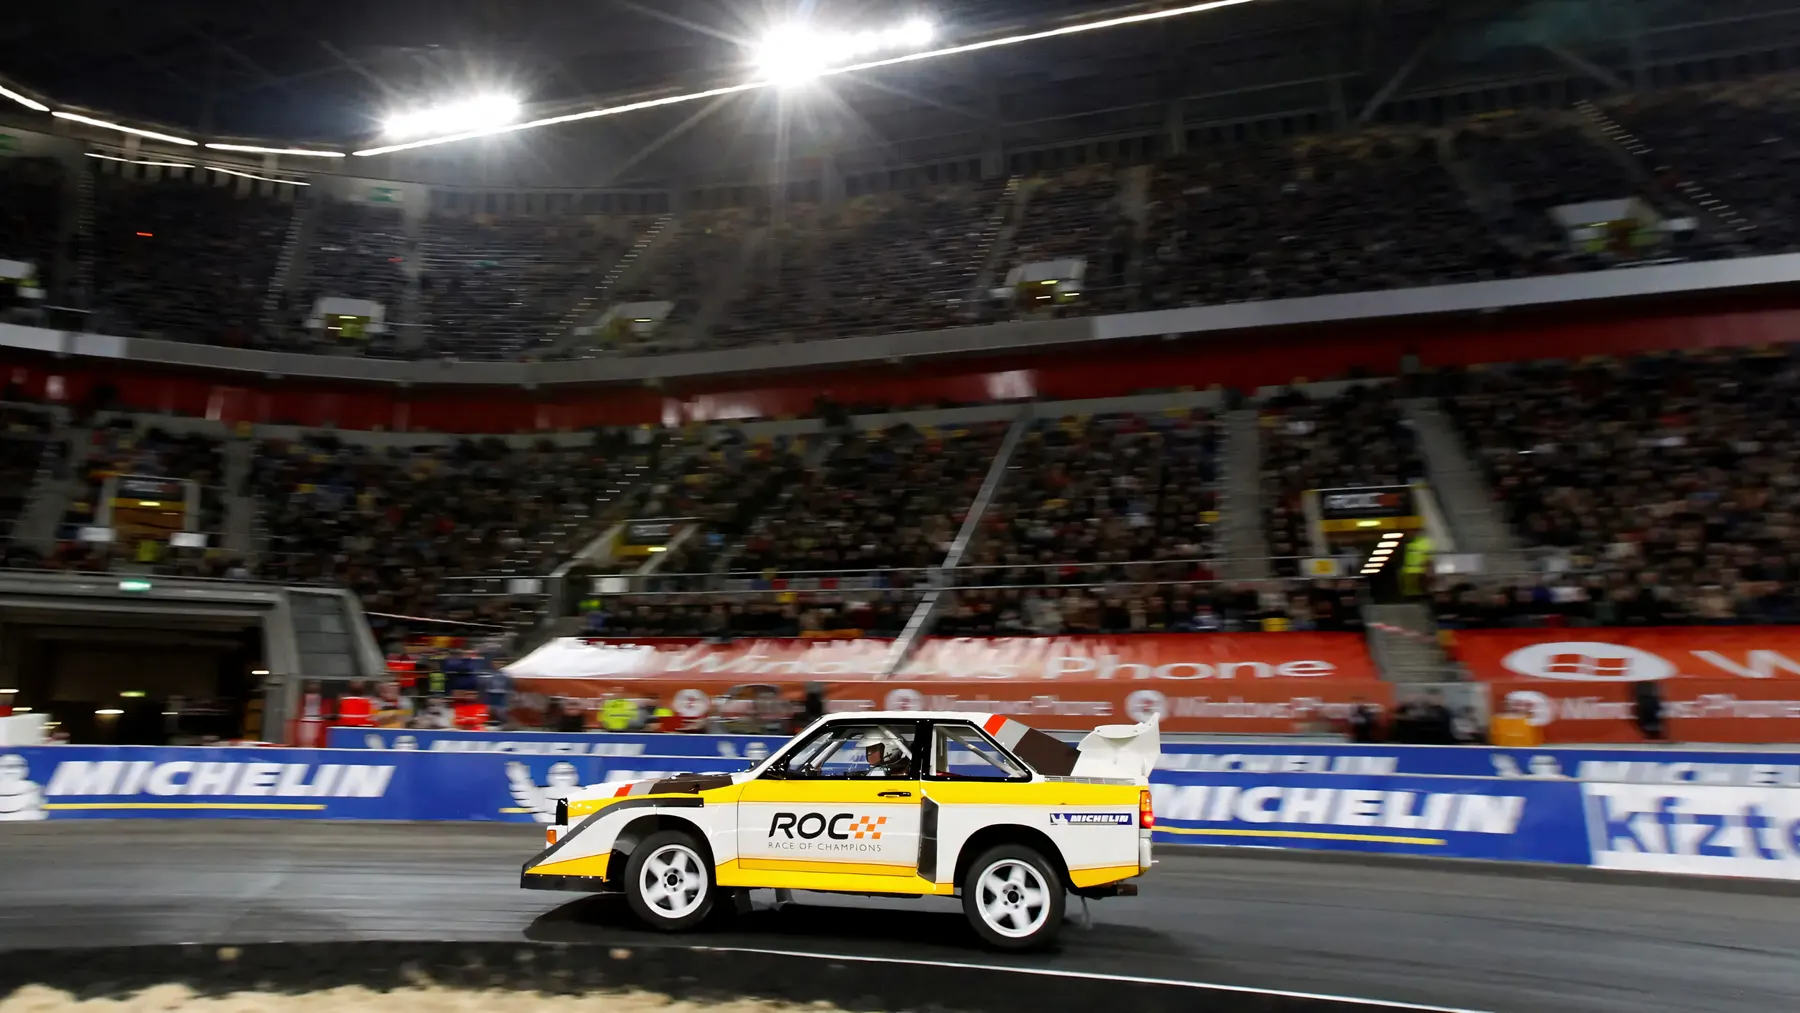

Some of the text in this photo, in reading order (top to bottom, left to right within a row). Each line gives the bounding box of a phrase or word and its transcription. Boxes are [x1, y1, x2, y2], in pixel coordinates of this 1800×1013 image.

[660, 647, 1337, 682] Winds Phone
[43, 761, 396, 798] MICHELIN
[1070, 815, 1129, 823] MICHELIN
[1150, 783, 1526, 834] MICHELIN
[768, 812, 854, 840] ROC
[768, 841, 882, 852] RACE OF CHAMPIONS
